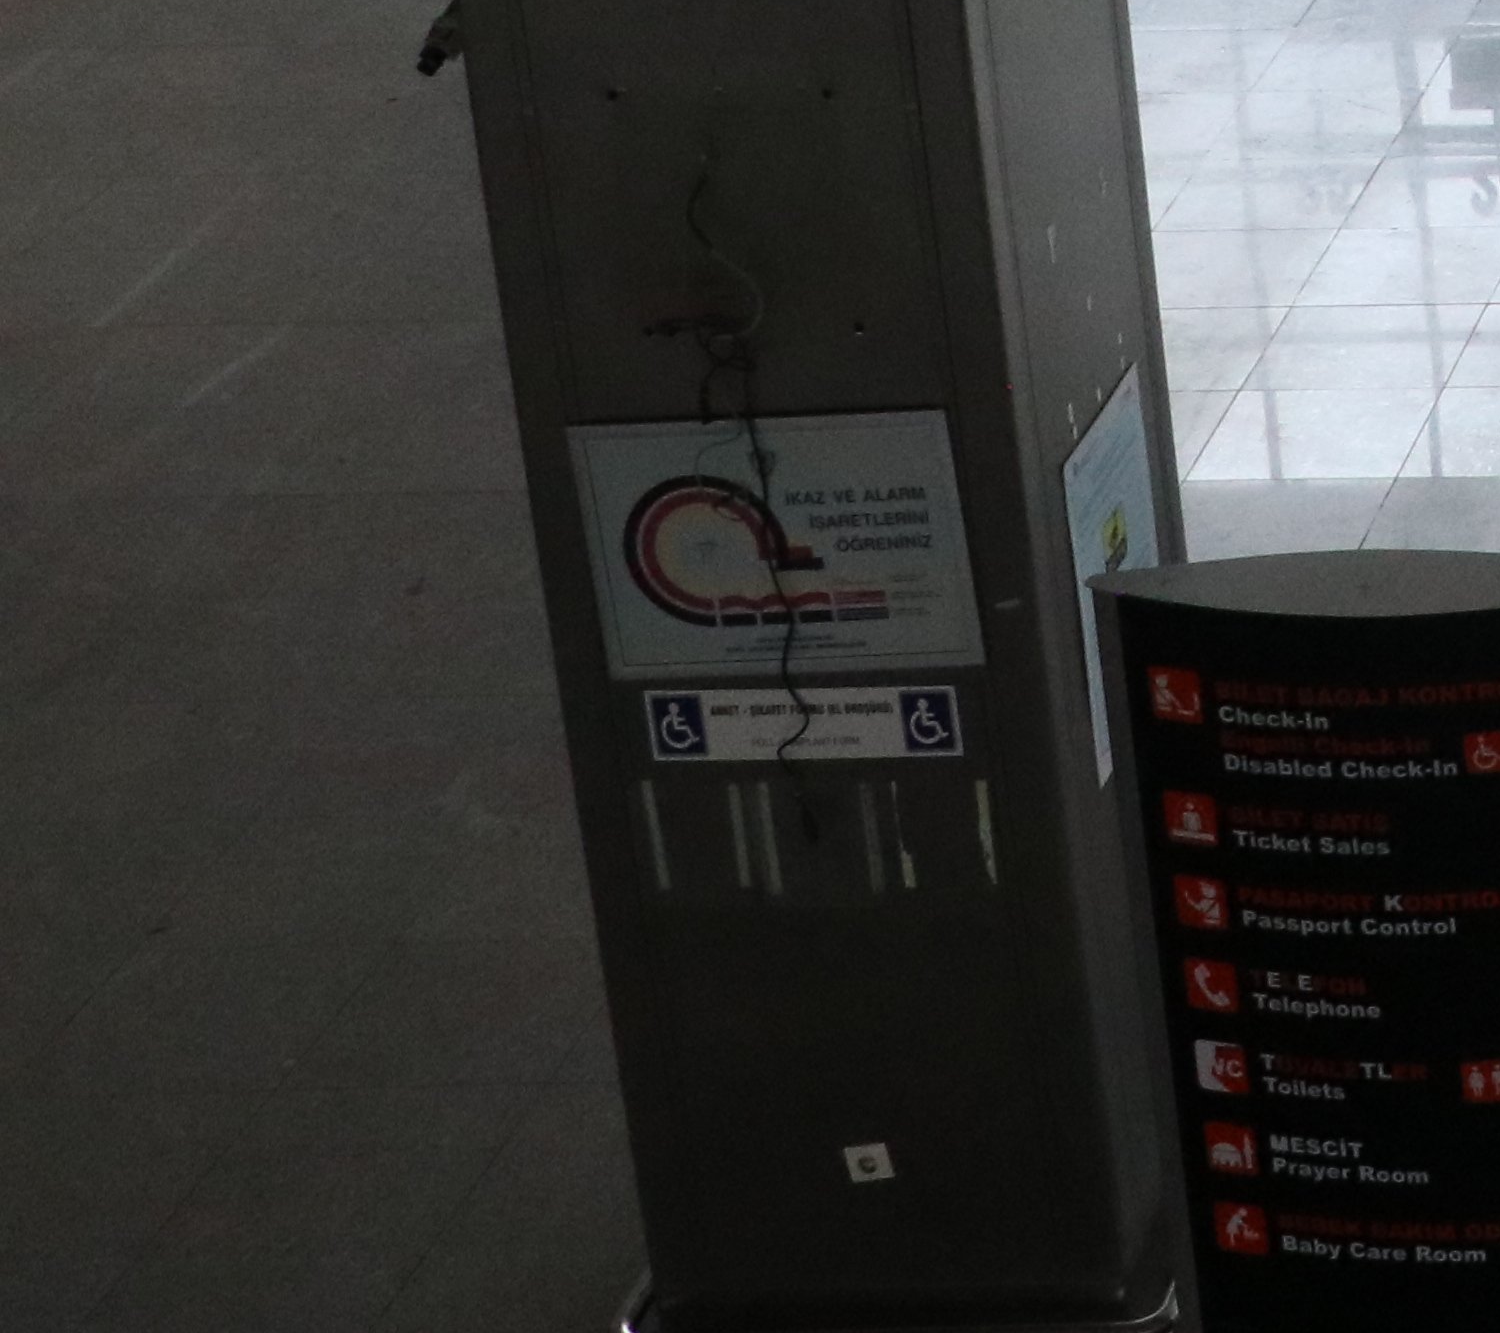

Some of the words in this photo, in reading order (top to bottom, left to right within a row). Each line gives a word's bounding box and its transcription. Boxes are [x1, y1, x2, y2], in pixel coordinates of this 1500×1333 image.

[834, 487, 856, 504] VE
[863, 485, 926, 503] ALARM
[1218, 706, 1330, 731] Check-In
[1223, 753, 1332, 778] Disabled
[1341, 759, 1459, 779] Check-In
[1231, 830, 1311, 854] Ticket
[1319, 832, 1391, 856] Sales
[1242, 910, 1354, 938] Passport
[1361, 917, 1458, 937] Control
[1252, 992, 1382, 1020] Telephone
[1263, 1077, 1347, 1100] Toilets
[1269, 1134, 1364, 1159] MESCİT
[1271, 1157, 1350, 1183] Prayer
[1358, 1164, 1431, 1184] Room
[1281, 1235, 1340, 1261] Baby
[1348, 1242, 1407, 1262] Care
[1414, 1244, 1488, 1263] Room
